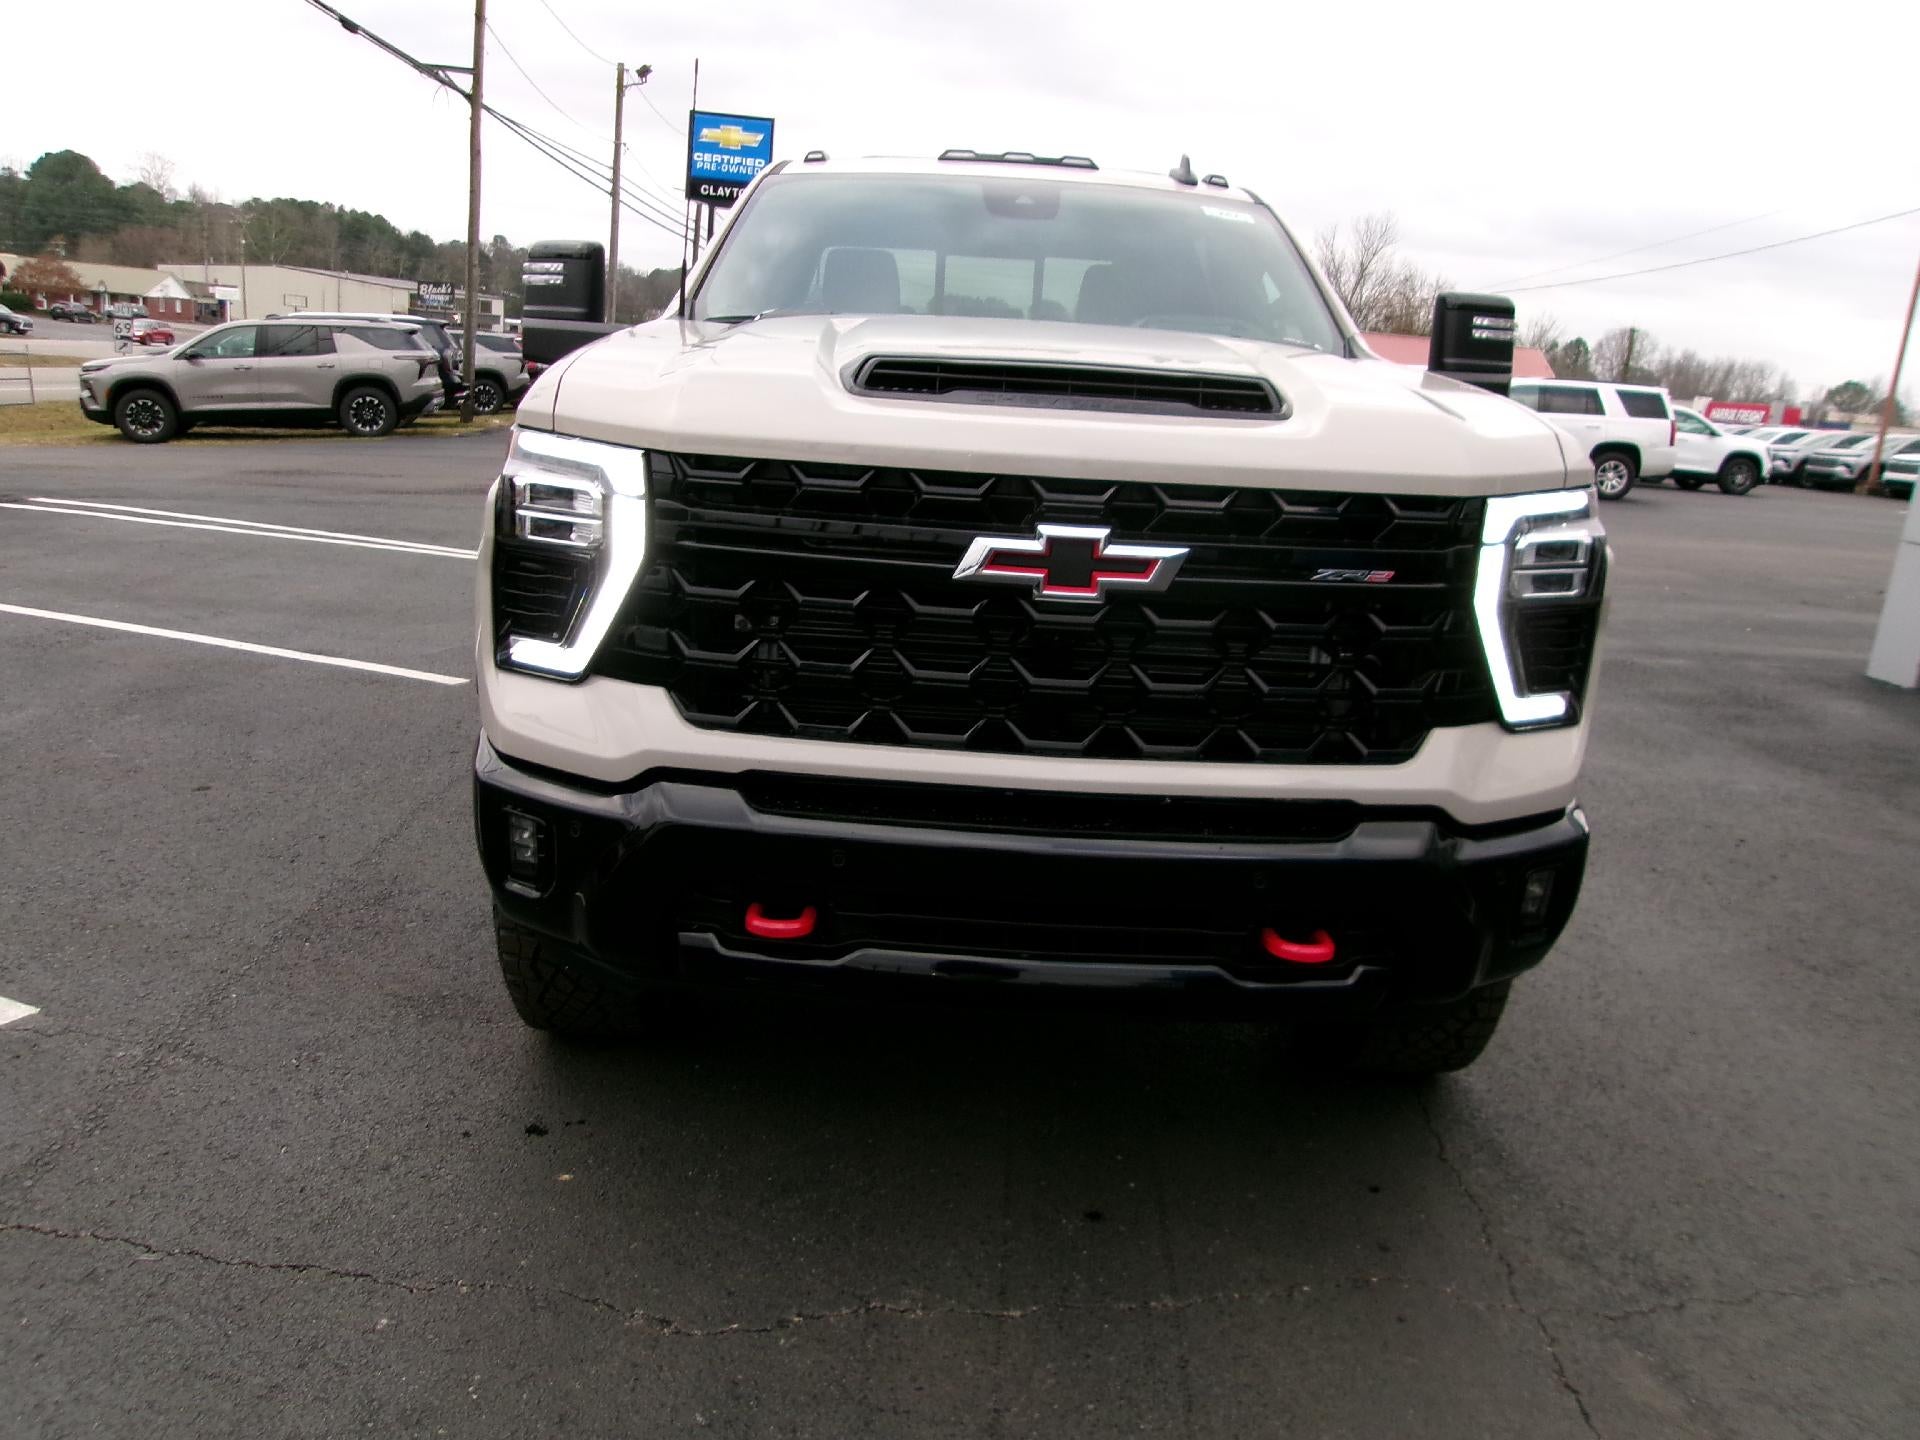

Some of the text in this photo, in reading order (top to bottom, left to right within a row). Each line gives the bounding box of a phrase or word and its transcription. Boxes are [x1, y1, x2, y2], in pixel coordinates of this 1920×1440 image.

[693, 152, 766, 167] CERTIFIED
[696, 162, 761, 175] PRE-OWNED
[115, 322, 132, 334] 69
[1310, 569, 1395, 583] ZR2
